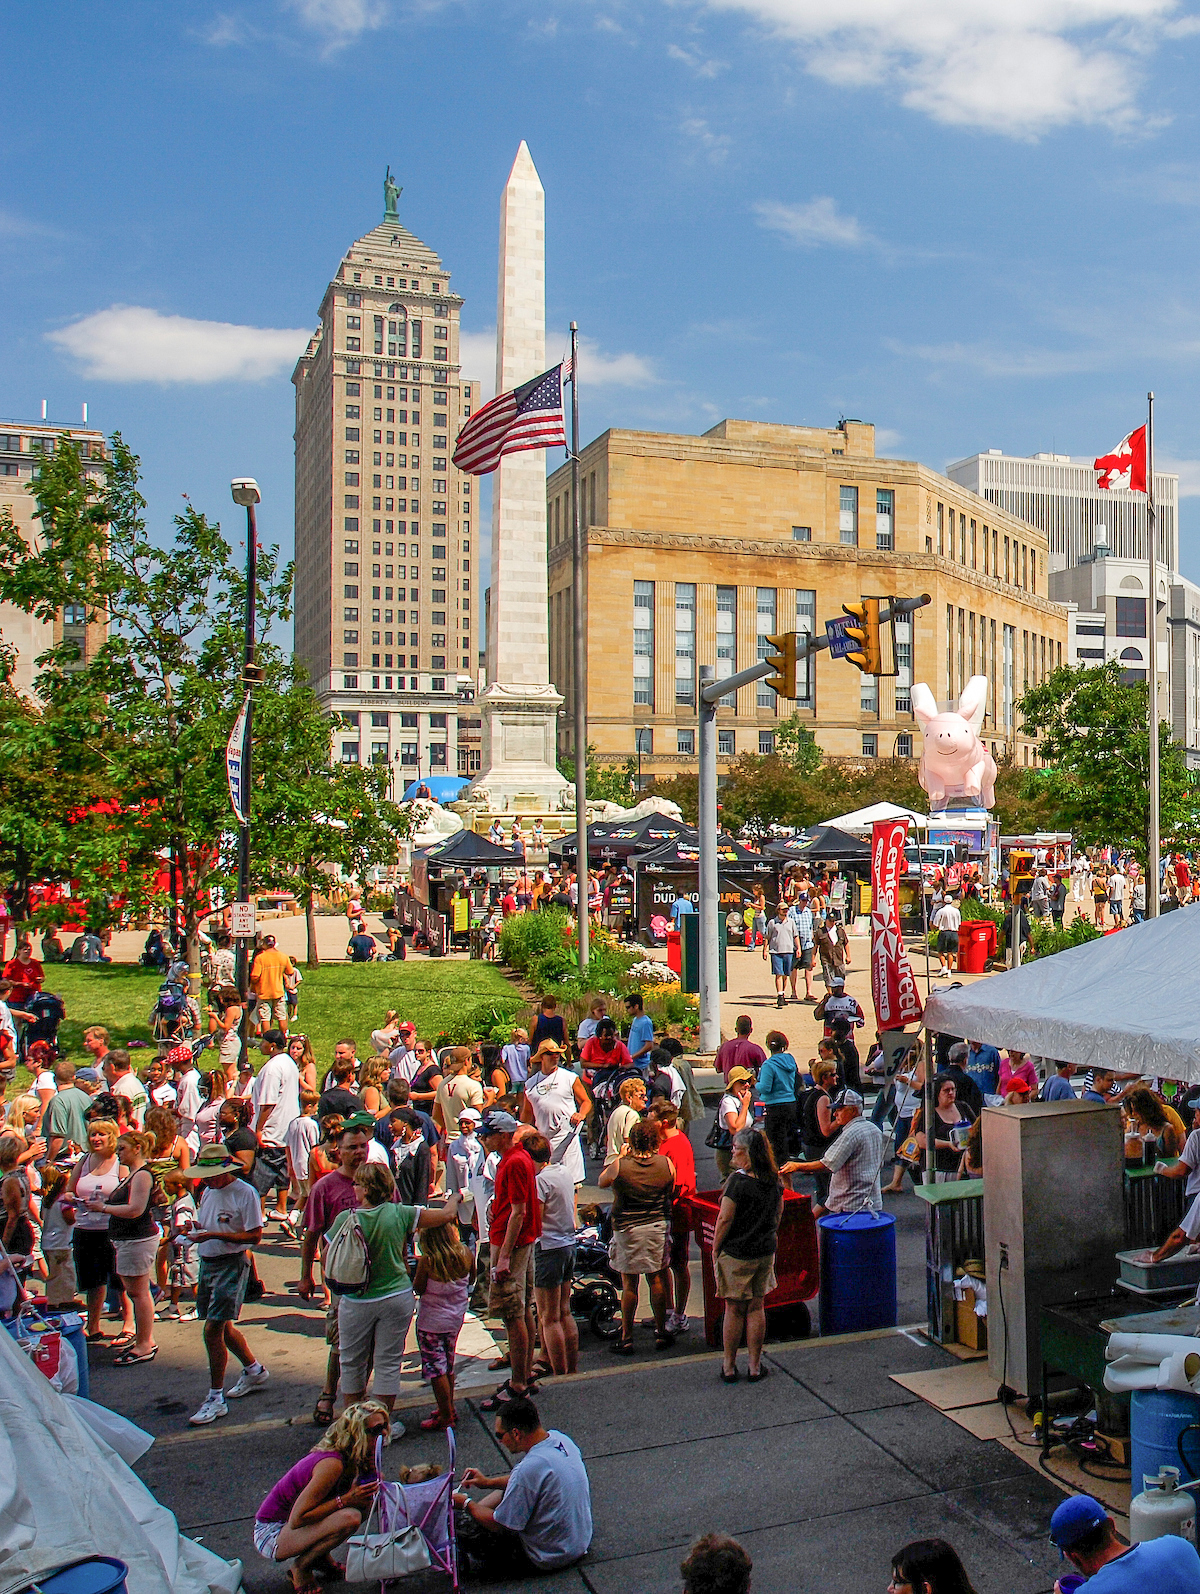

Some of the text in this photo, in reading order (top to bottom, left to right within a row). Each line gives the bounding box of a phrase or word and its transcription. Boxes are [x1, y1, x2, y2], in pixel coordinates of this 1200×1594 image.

[653, 893, 676, 904] DUD
[883, 825, 906, 918] Center
[879, 953, 890, 1014] HOUSE
[896, 940, 921, 1020] Street
[447, 1083, 457, 1097] V
